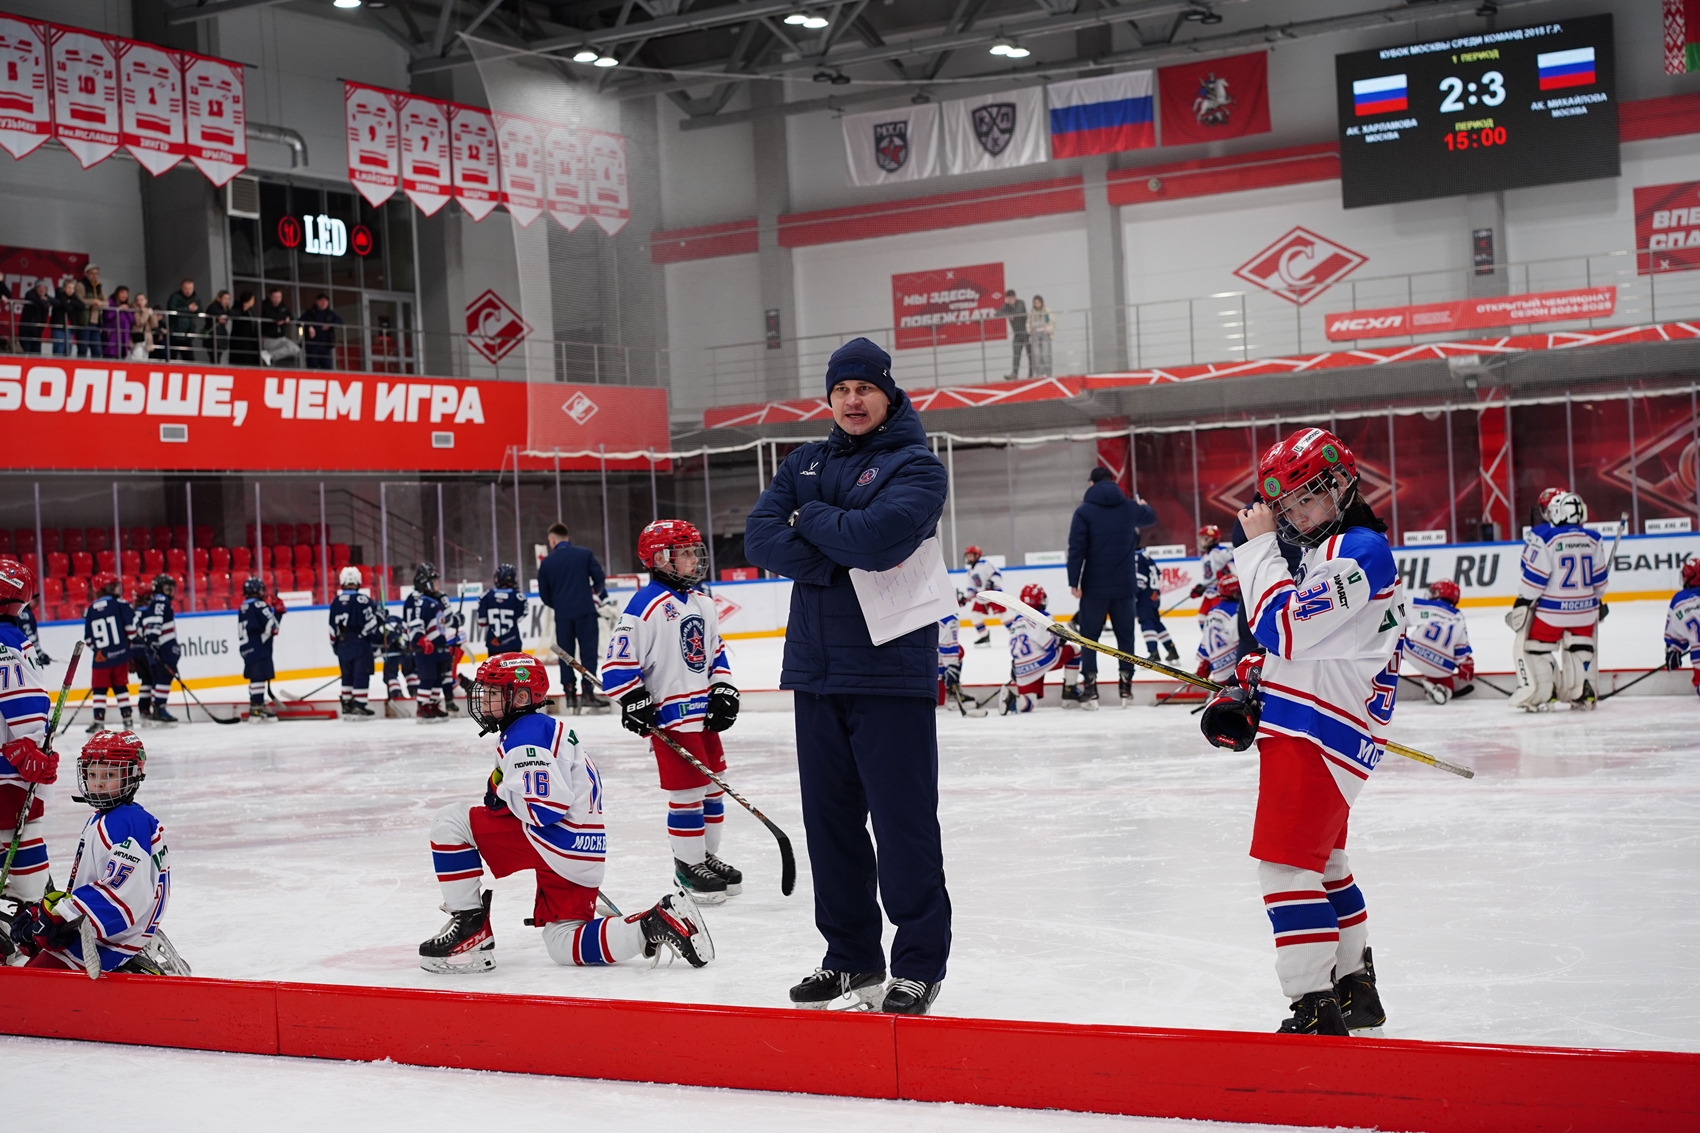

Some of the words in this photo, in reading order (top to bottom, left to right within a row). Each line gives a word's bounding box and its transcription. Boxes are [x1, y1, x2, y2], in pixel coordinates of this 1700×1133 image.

[1380, 46, 1409, 59] КУБОК
[1409, 41, 1451, 55] МОСКВЫ
[1451, 36, 1483, 49] СРЕДИ
[1484, 30, 1523, 44] КОМАНД
[1451, 55, 1458, 64] 1
[1460, 49, 1500, 62] ПЕРИОД
[78, 75, 96, 95] 10
[1439, 71, 1507, 113] 2:3
[148, 87, 157, 105] 1
[1547, 92, 1608, 109] МИХАЙЛОВА
[1551, 106, 1588, 118] МОСКВА
[876, 122, 905, 136] МХЛ
[1362, 118, 1418, 134] ХАРЛАМОВА
[1455, 118, 1494, 131] ПЕРИОД
[421, 135, 429, 152] 7
[1365, 131, 1400, 143] МОСКВА
[1443, 126, 1507, 151] 15:00
[903, 293, 927, 306] МЫ
[929, 288, 979, 304] ЗДЕСЬ,
[1476, 298, 1541, 313] ОТКРЫТЫЙ
[1542, 292, 1611, 306] ЧЕМПИОНАТ
[1510, 308, 1549, 319] СЕЗОН
[1330, 315, 1403, 333] НСХЛ
[0, 365, 248, 427] БОЛЬШЕ,
[264, 377, 363, 421] ЧЕМ
[374, 382, 485, 424] ИГРА
[1559, 554, 1594, 590] 20
[1614, 552, 1693, 572] БАНК
[1560, 600, 1593, 611] МОСКВА
[91, 615, 120, 649] 91
[487, 608, 514, 637] 55
[1424, 622, 1454, 648] 51
[1411, 645, 1444, 666] МОСКВА
[0, 663, 25, 690] 71
[1518, 659, 1530, 687] CCM
[522, 770, 550, 798] 16
[103, 859, 135, 890] 25
